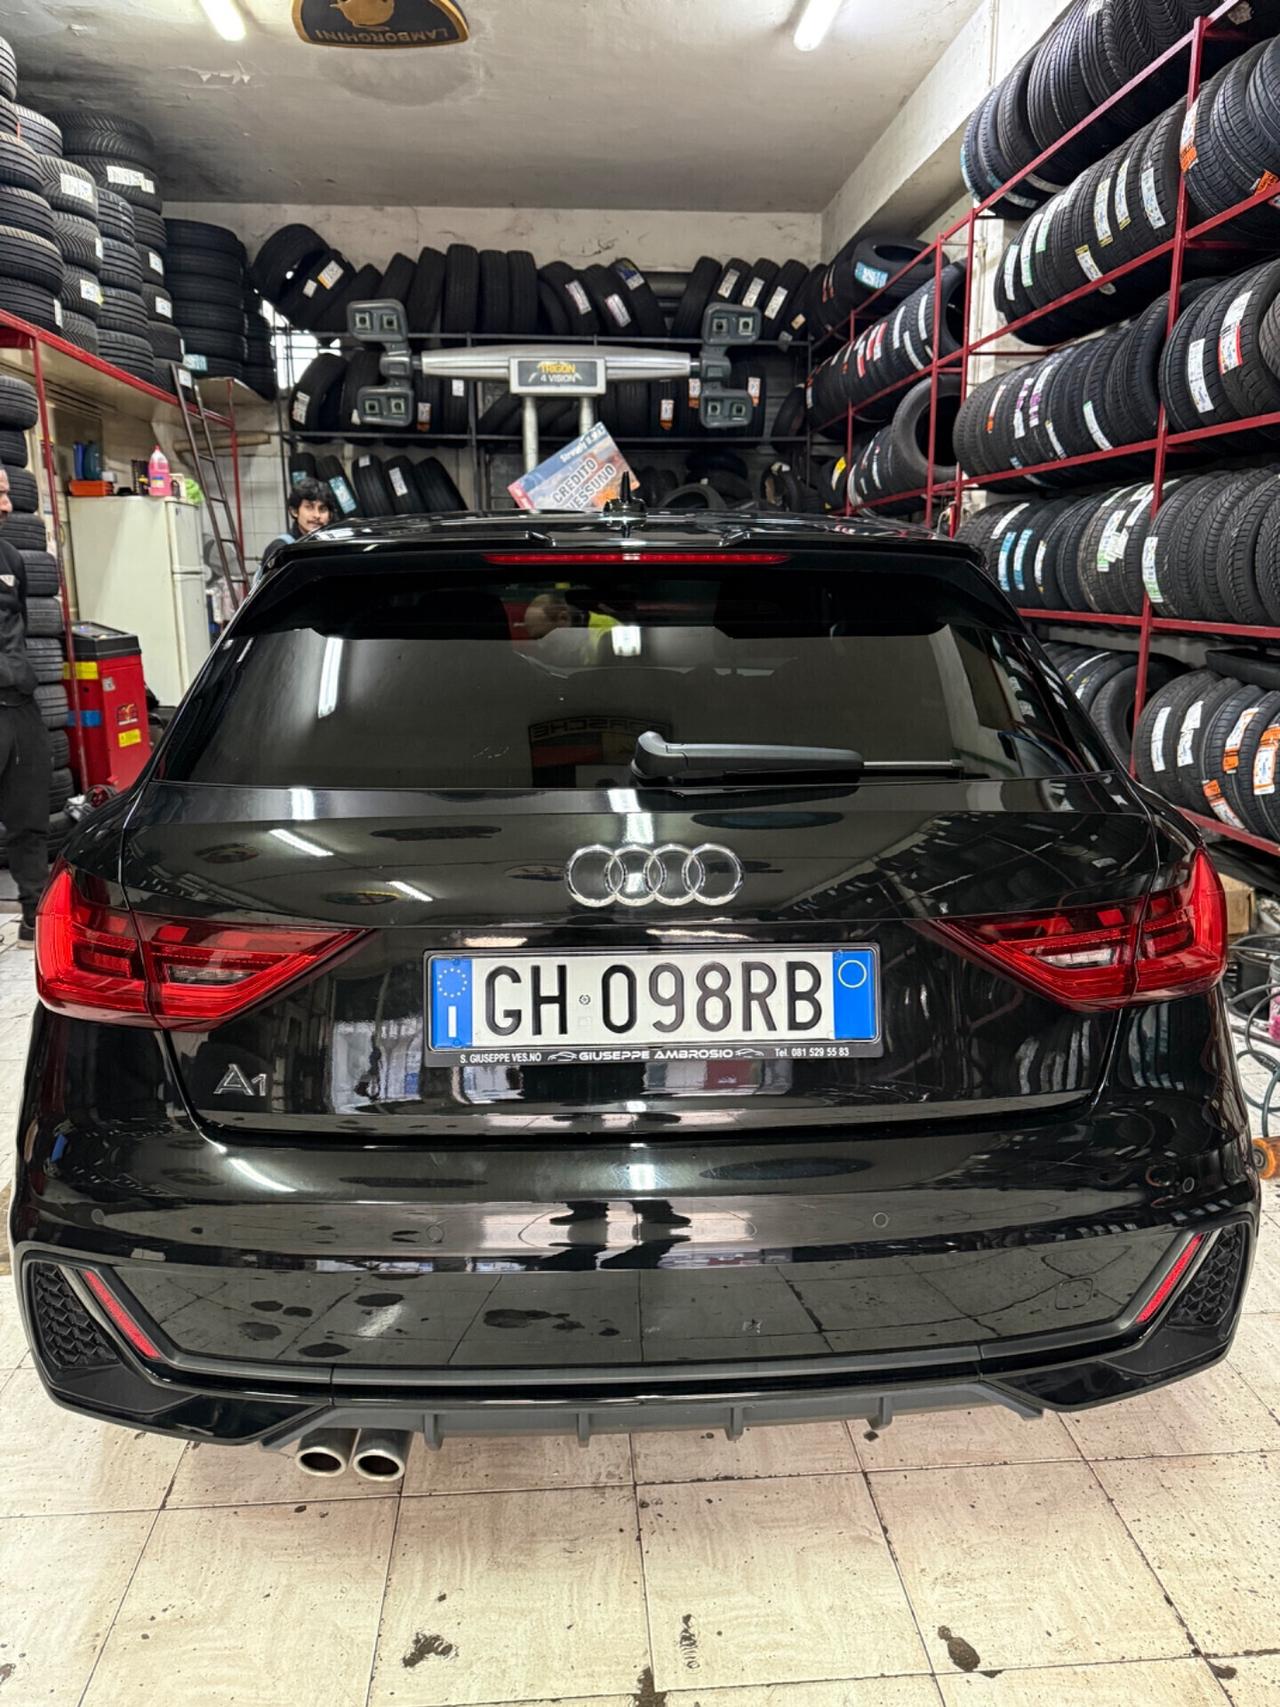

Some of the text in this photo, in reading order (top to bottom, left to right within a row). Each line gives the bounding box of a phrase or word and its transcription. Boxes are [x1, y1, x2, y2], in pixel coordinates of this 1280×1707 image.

[315, 28, 449, 43] LAMBORGHINI
[552, 458, 597, 504] CREDITO
[485, 961, 823, 1036] GH 098RB
[460, 1052, 542, 1063] S. GIUSEPPE VES.NO
[578, 1049, 734, 1061] GIUSEPPE AMBROSIO
[791, 1047, 807, 1057] 081
[808, 1047, 824, 1057] 529
[826, 1047, 837, 1057] 55
[838, 1047, 850, 1056] 83
[213, 1064, 267, 1096] A1
